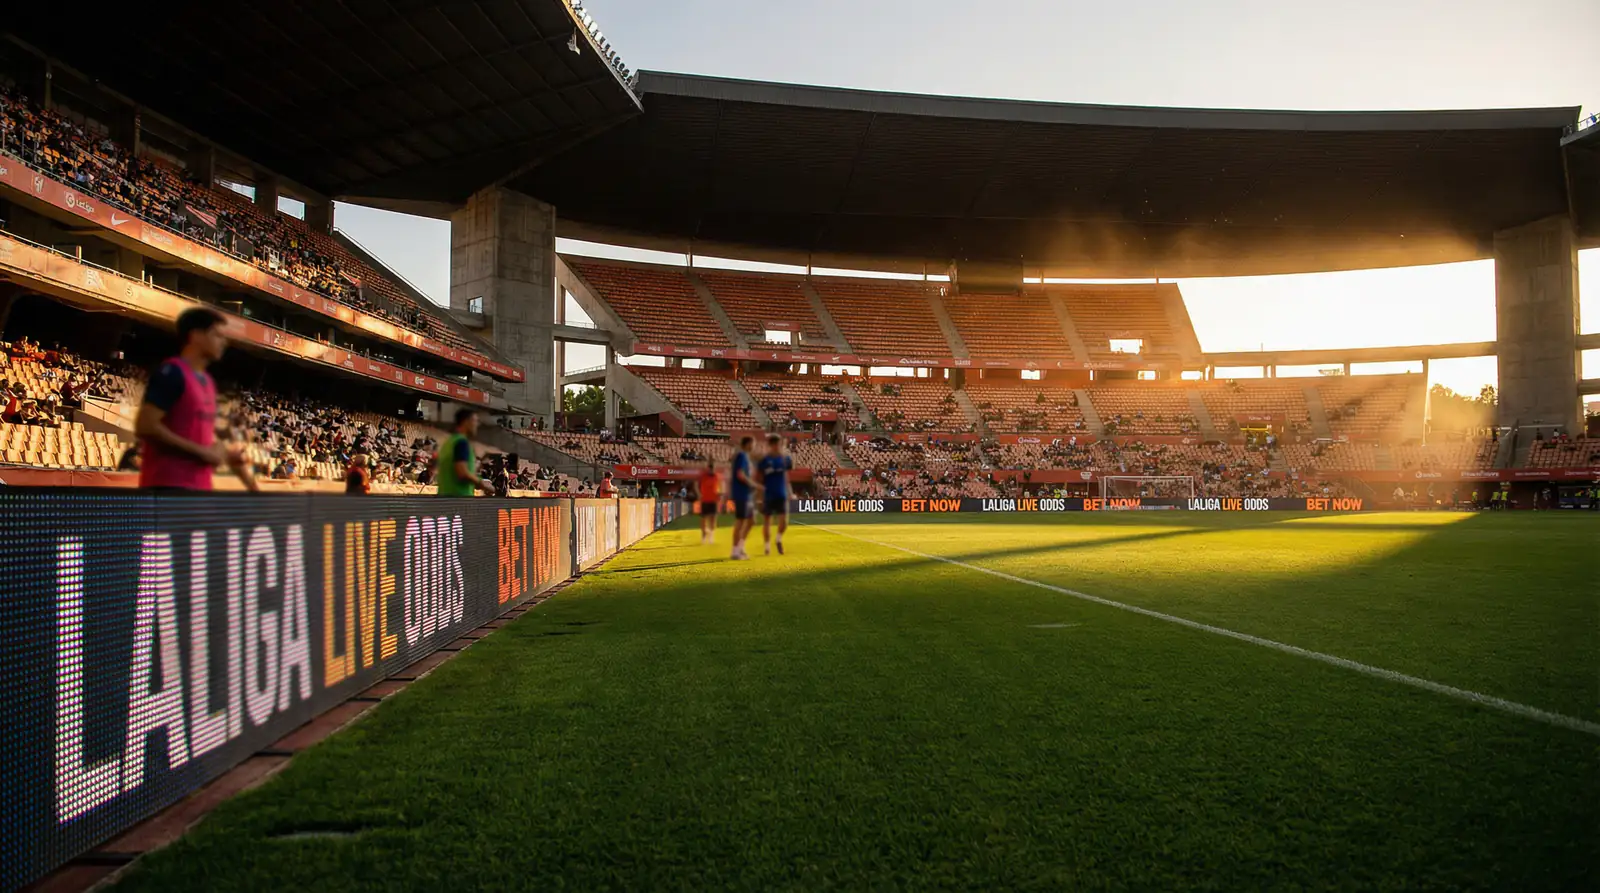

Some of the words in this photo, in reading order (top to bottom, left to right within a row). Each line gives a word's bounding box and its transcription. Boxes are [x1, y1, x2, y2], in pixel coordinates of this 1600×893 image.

[798, 500, 833, 512] LALIGA
[835, 500, 856, 512] LIVE
[858, 500, 884, 512] ODDS
[902, 500, 927, 512] BET
[929, 500, 961, 512] NOW
[982, 499, 1016, 511] LALIGA
[1017, 499, 1038, 511] LIVE
[1040, 499, 1065, 511] ODDS
[1188, 498, 1221, 511] LALIGA
[1222, 499, 1242, 511] LIVE
[1244, 499, 1269, 511] ODDS
[1306, 499, 1329, 511] BET
[1333, 499, 1363, 511] NOW
[497, 507, 530, 605] BET
[532, 505, 561, 589] NOW
[56, 524, 312, 824] LALIGA
[323, 518, 398, 688] LIVE
[403, 514, 464, 647] ODDS
